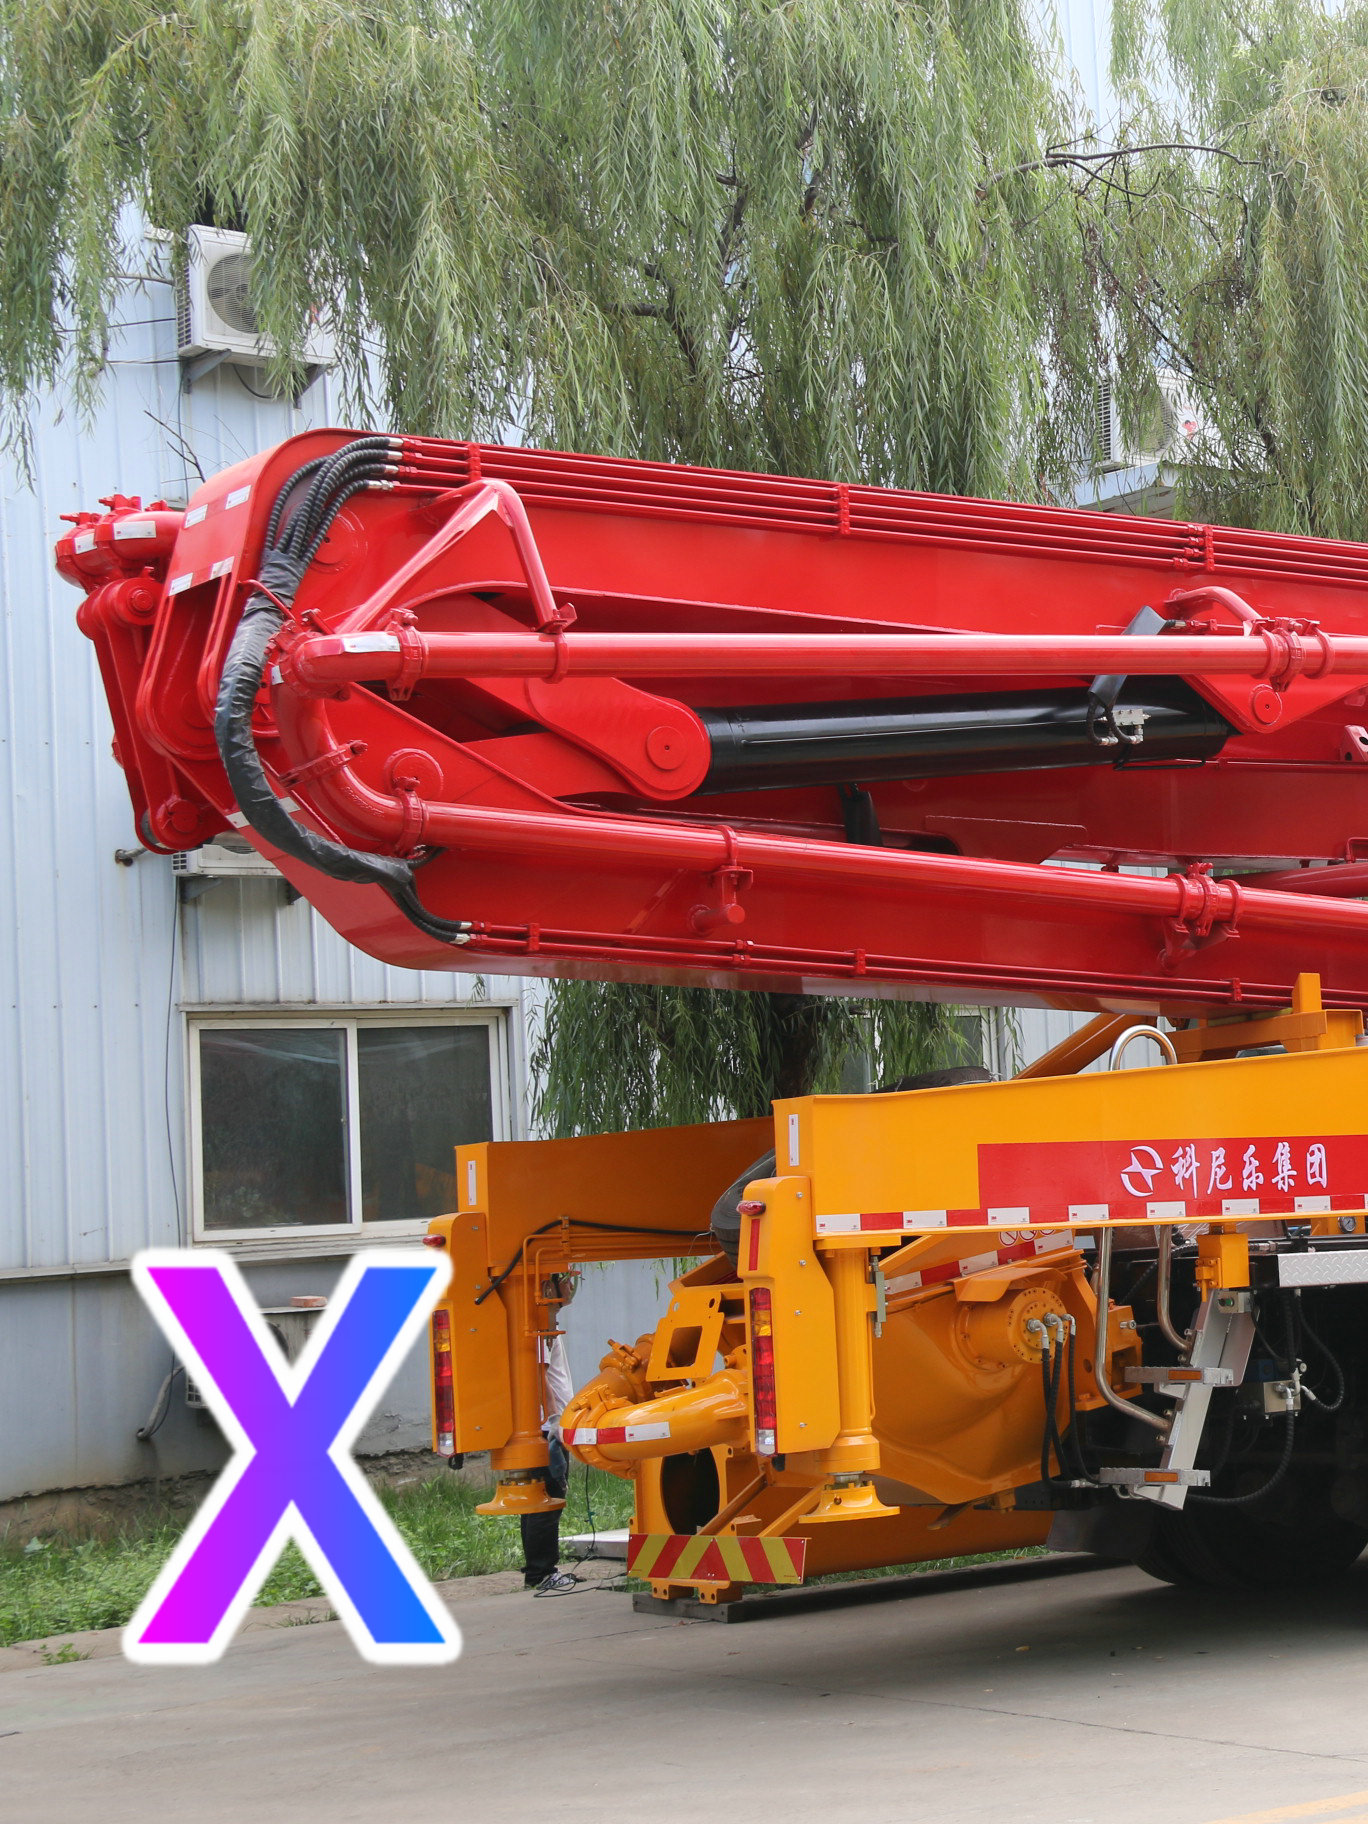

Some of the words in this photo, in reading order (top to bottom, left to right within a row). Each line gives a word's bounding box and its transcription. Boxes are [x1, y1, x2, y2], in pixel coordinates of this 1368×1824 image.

[1170, 1141, 1328, 1199] 科尼乐集团
